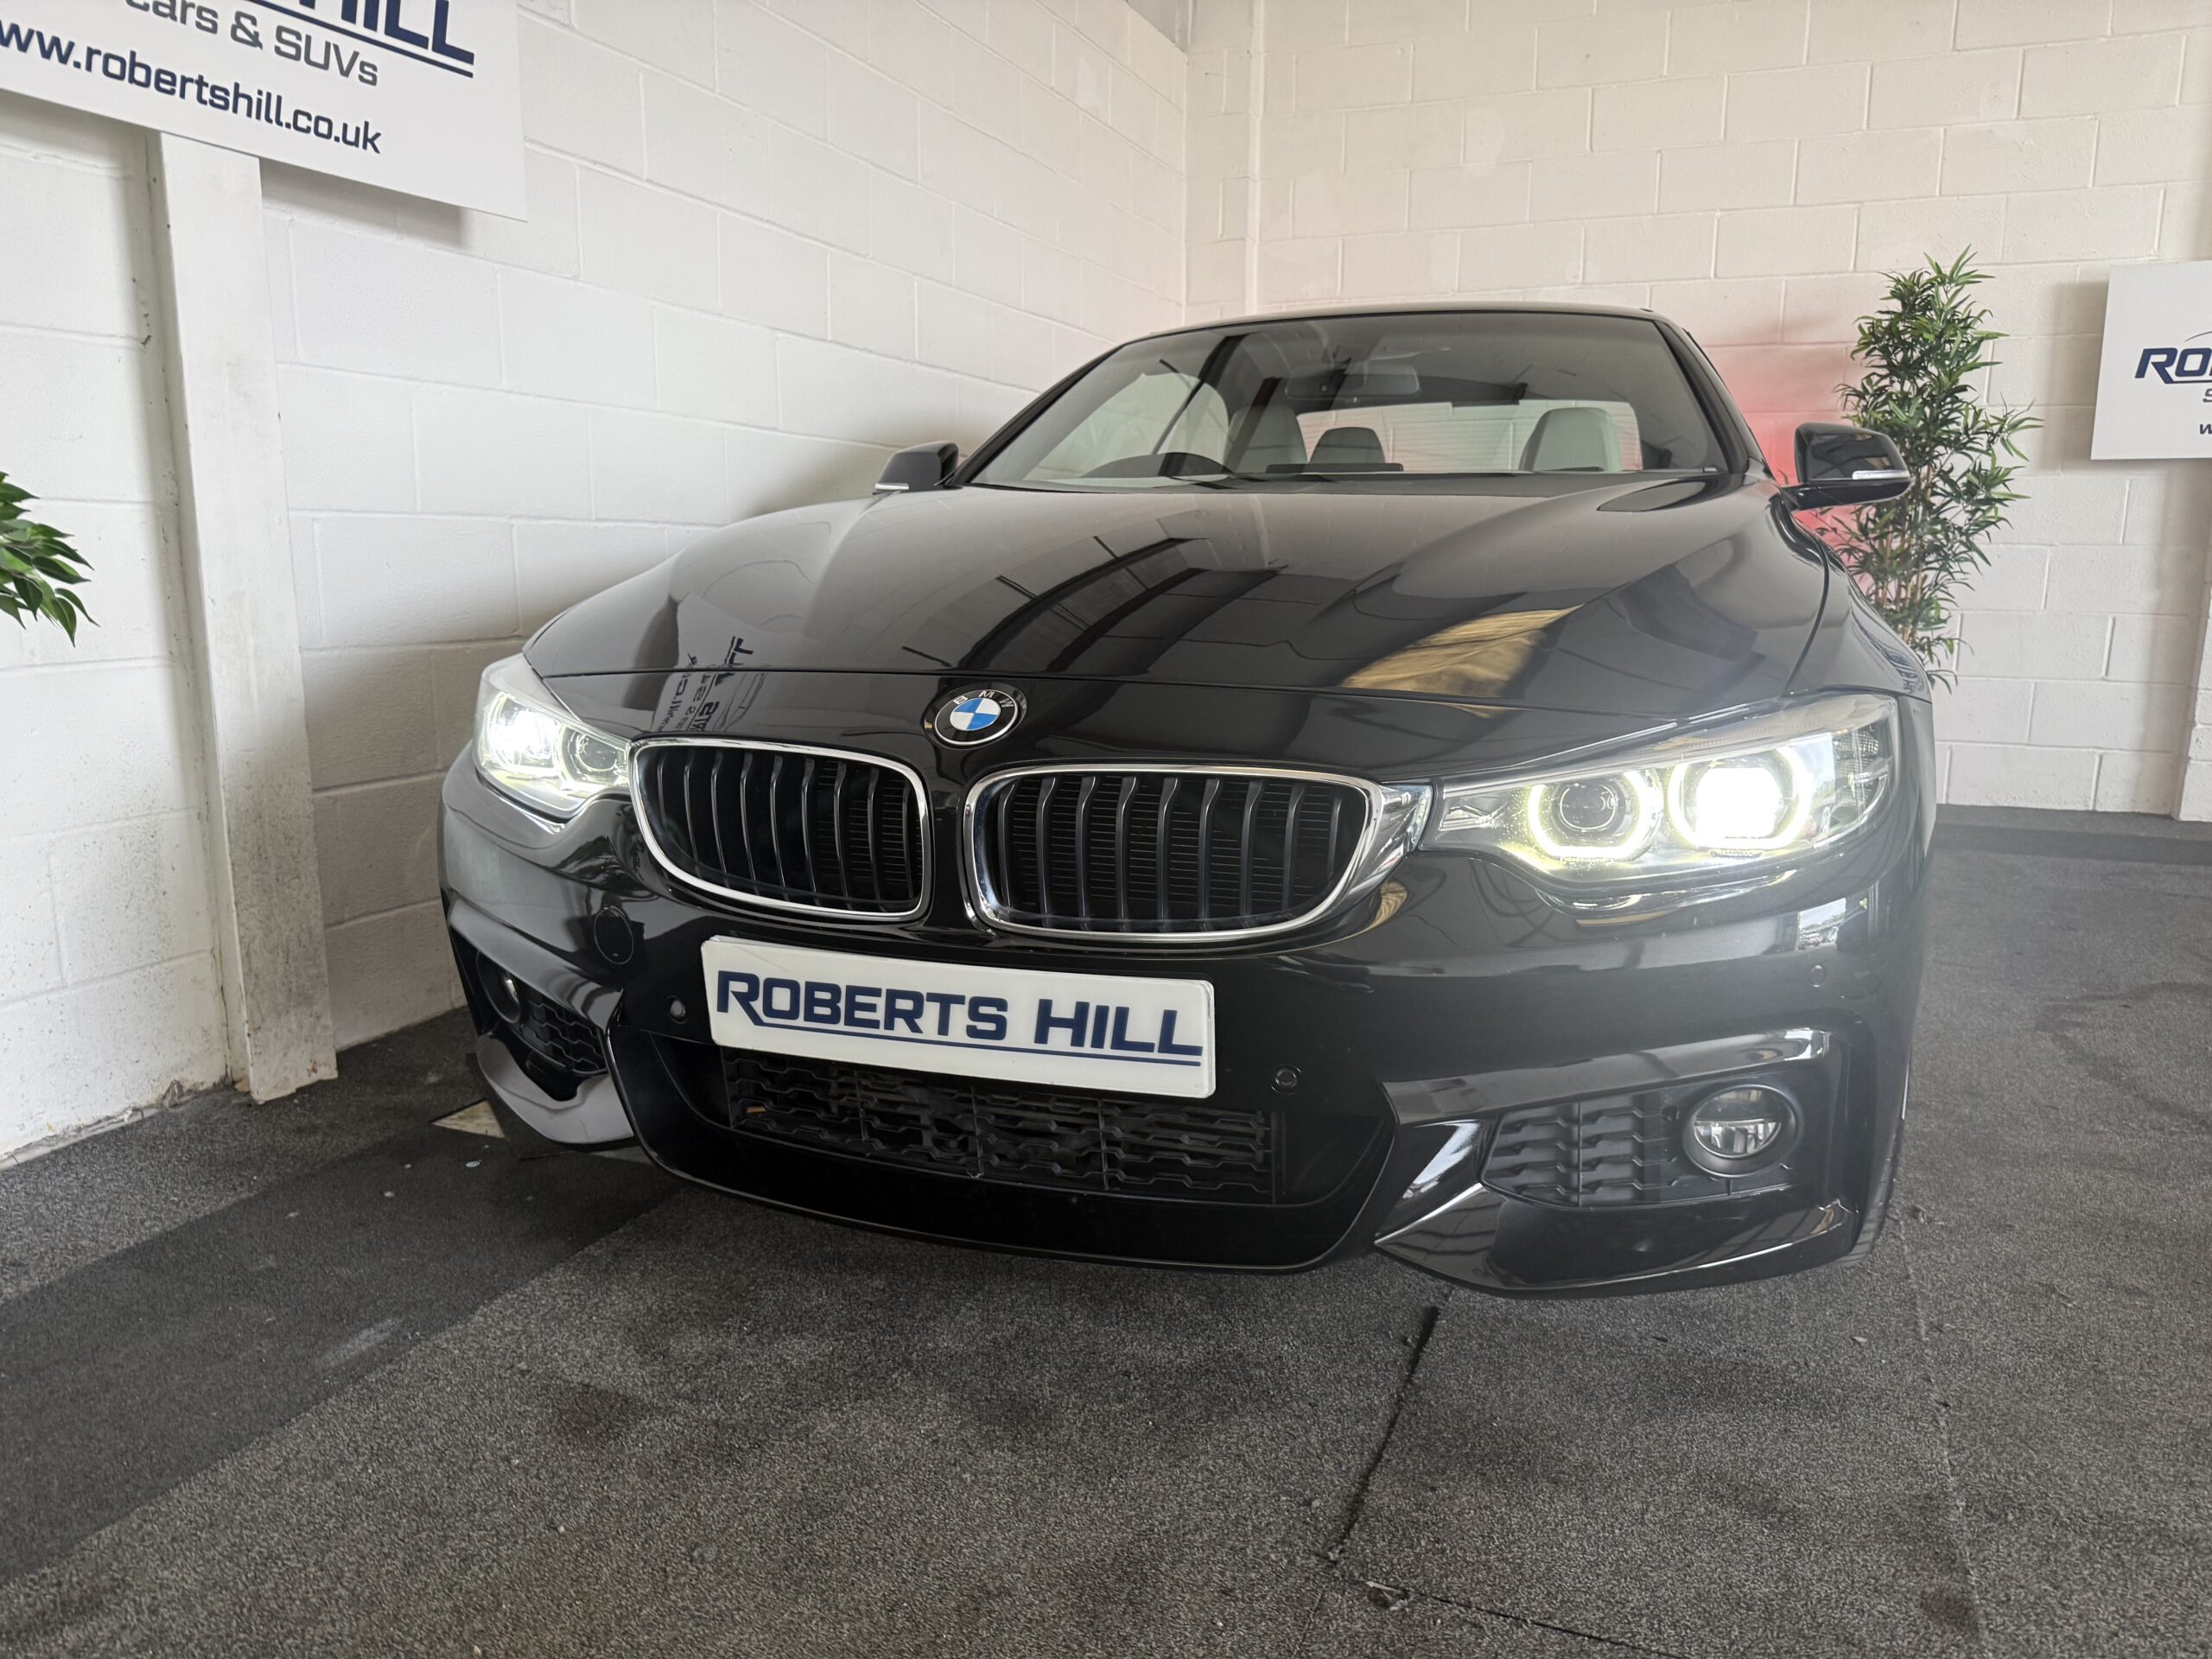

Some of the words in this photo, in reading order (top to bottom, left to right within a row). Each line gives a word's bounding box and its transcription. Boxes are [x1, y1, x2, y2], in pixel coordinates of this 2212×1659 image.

[230, 11, 263, 50] &
[274, 25, 378, 86] SUVs
[2134, 347, 2212, 385] RO
[953, 690, 1014, 708] BMW
[716, 969, 1007, 1040] ROBERTS
[1034, 999, 1203, 1057] HILL
